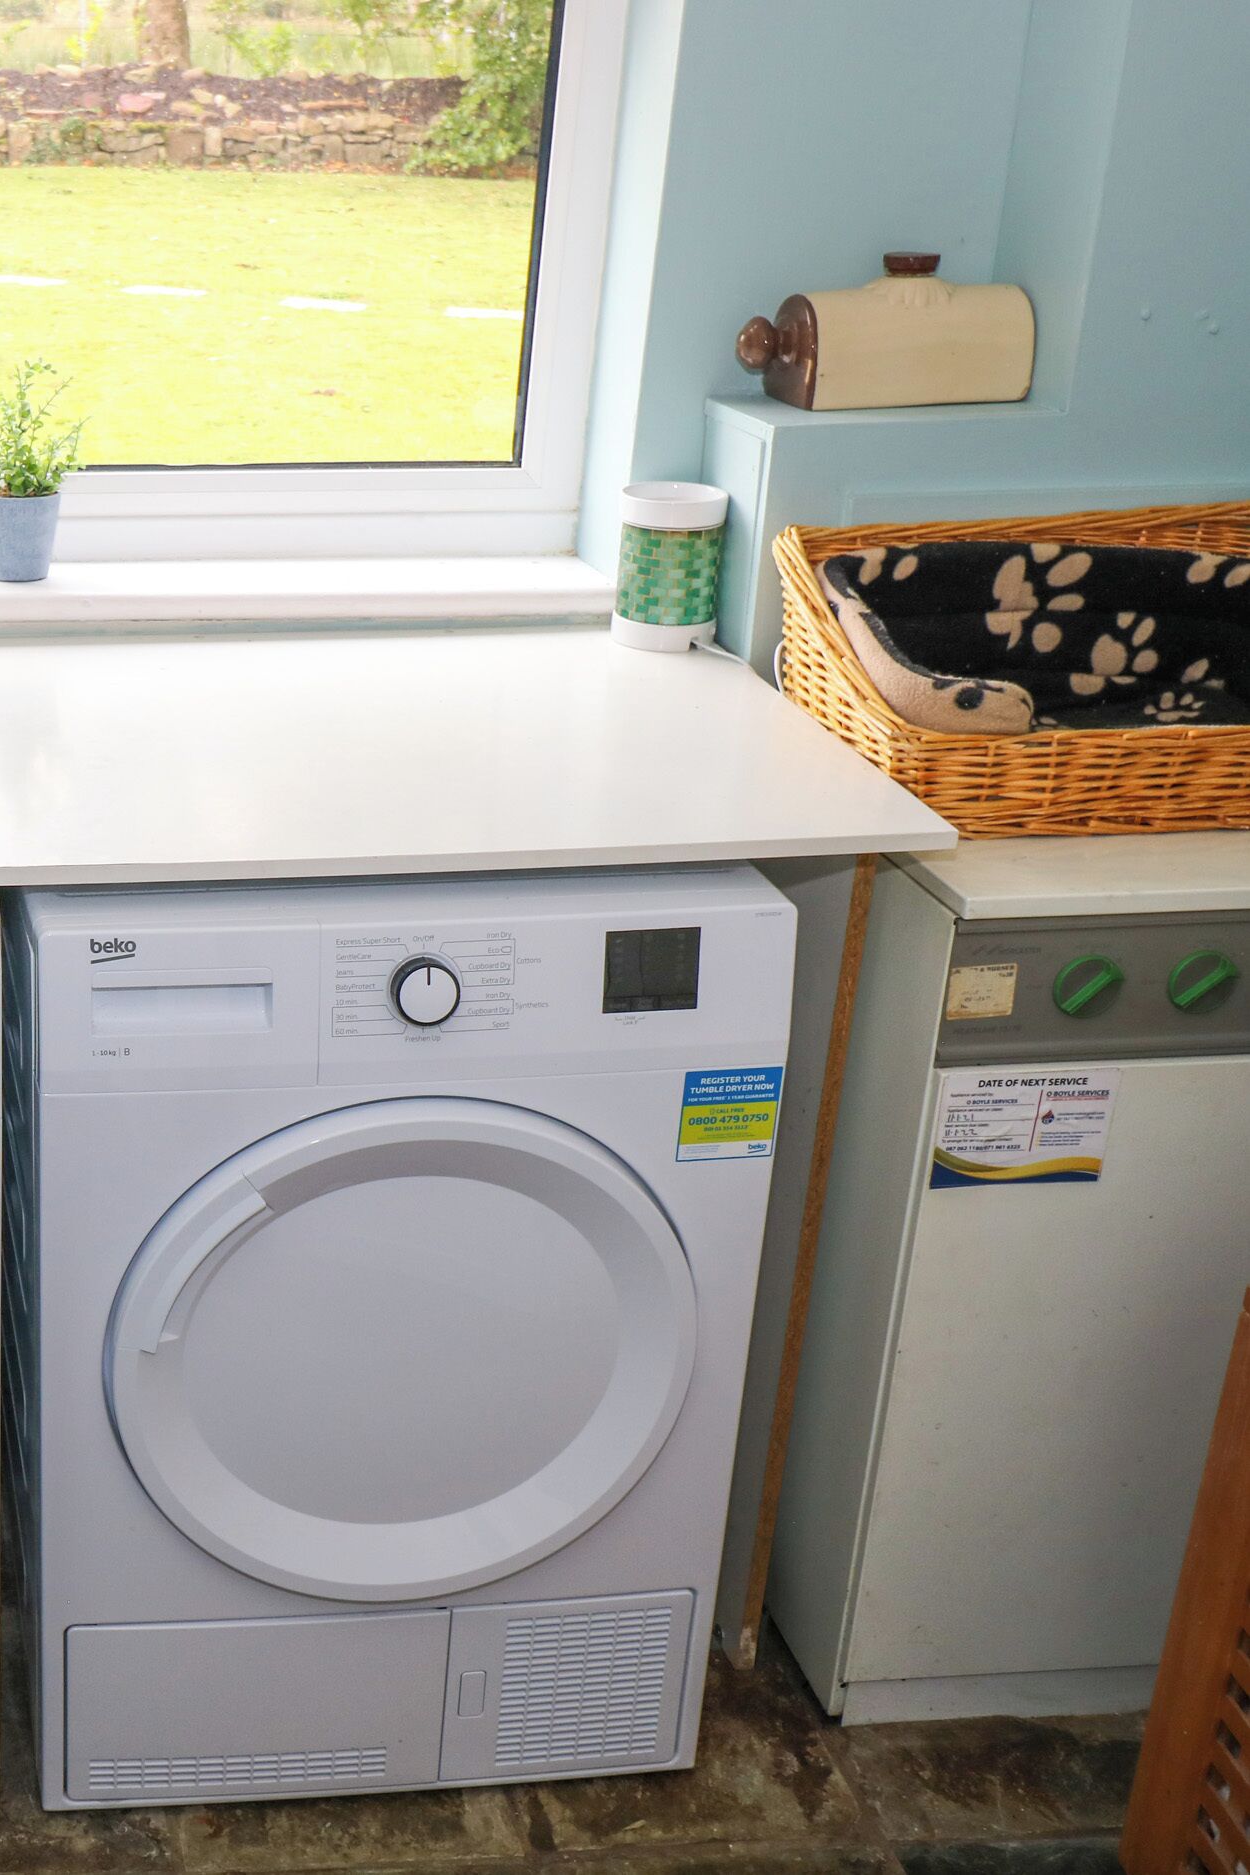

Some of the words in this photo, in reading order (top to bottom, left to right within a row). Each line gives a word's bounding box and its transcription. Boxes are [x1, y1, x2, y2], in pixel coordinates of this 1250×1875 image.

[500, 931, 512, 939] Dry
[90, 938, 137, 953] beko
[335, 938, 361, 946] Express
[363, 938, 382, 946] Super
[516, 957, 542, 965] Cottons
[468, 962, 499, 970] Cupboard
[500, 962, 511, 970] Dry
[515, 1002, 549, 1010] Synthetics
[467, 1007, 498, 1016] Cupboard
[499, 1007, 510, 1015] Dry
[492, 1021, 510, 1029] Sport
[431, 1034, 441, 1042] Up
[700, 1076, 741, 1085] REGISTER
[743, 1074, 766, 1082] YOUR
[978, 1079, 1003, 1088] DATE
[1005, 1079, 1019, 1087] OF
[1020, 1078, 1047, 1087] NEXT
[1048, 1077, 1089, 1086] SERVICE
[690, 1085, 725, 1094] TUMBLE
[725, 1084, 753, 1092] DRYER
[754, 1083, 775, 1091] NOW
[688, 1116, 718, 1126] 0800
[719, 1115, 740, 1124] 479
[742, 1113, 769, 1122] 0750
